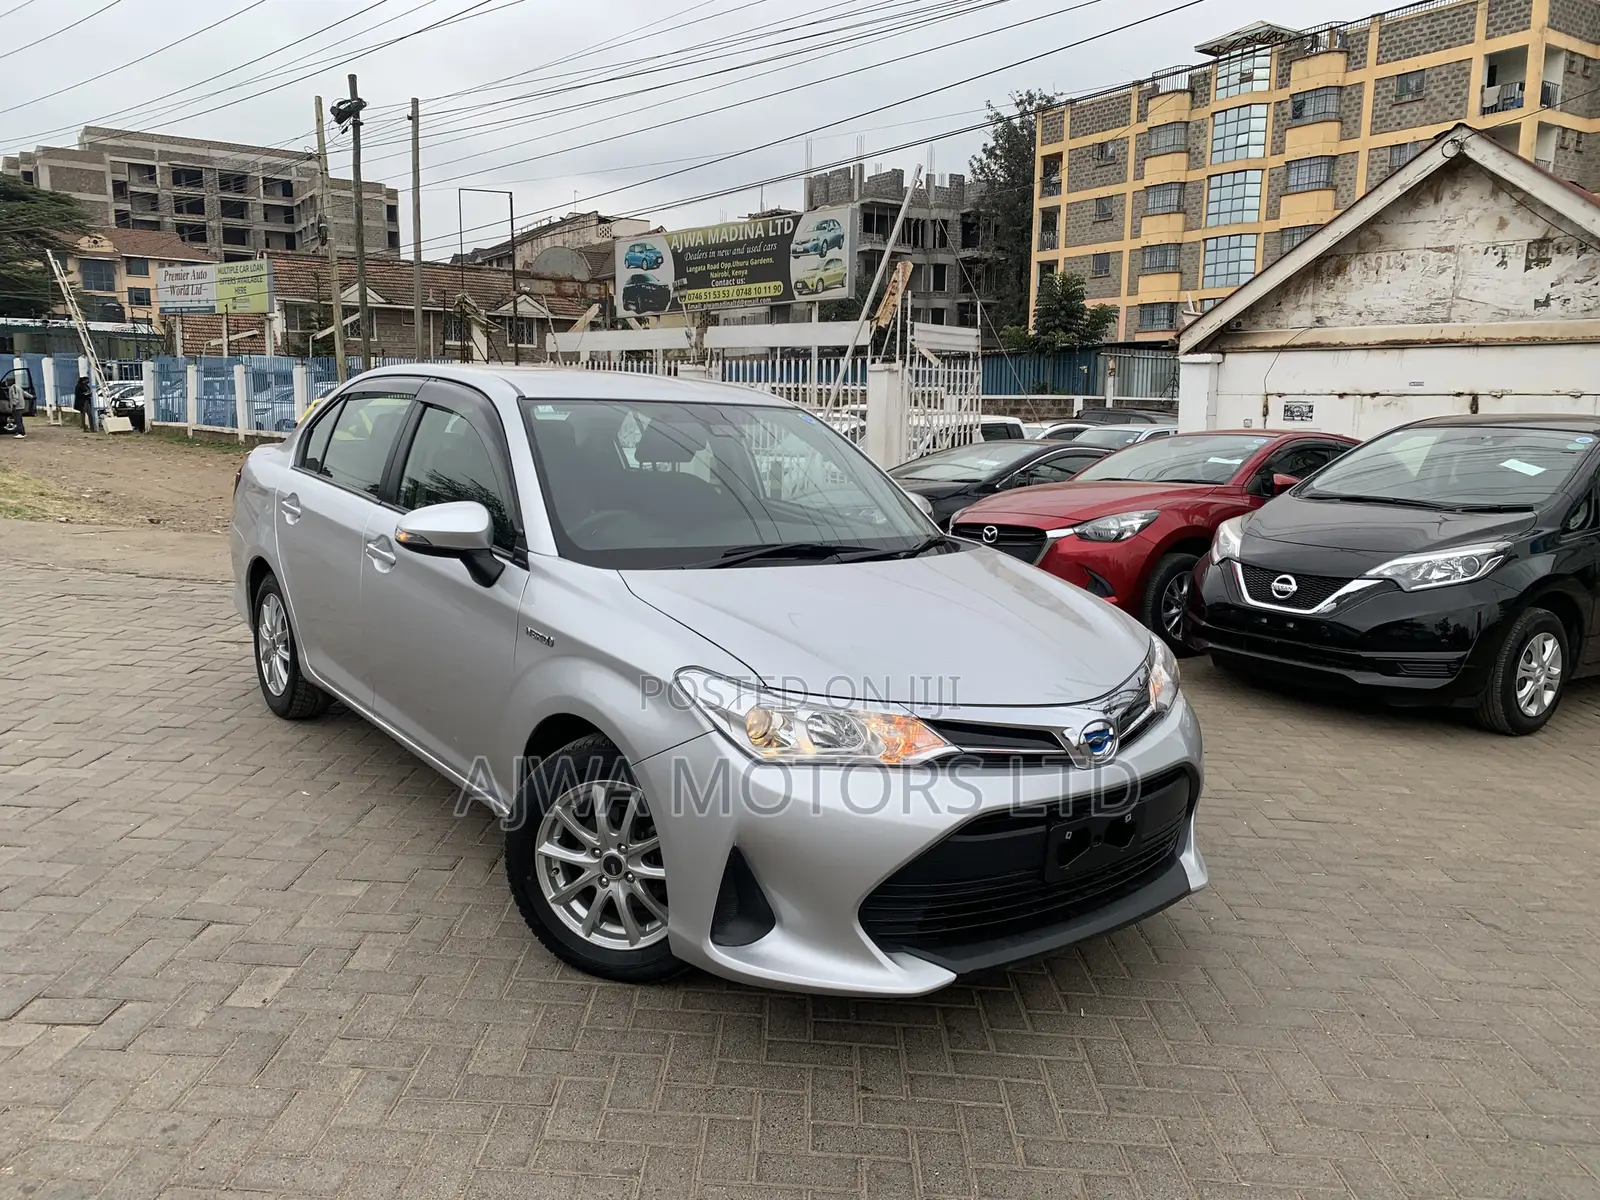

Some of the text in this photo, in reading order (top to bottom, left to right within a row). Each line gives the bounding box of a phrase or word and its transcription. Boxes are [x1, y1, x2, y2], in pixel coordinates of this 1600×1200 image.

[671, 217, 794, 253] AJWA MADINA LTD
[683, 241, 777, 261] Dealers in new and used cars
[217, 263, 264, 275] MULTIPLE CAR LOAN
[686, 264, 706, 273] Langata
[707, 262, 719, 271] Road
[732, 269, 748, 278] Kenya
[163, 269, 208, 281] Premier Auto
[220, 276, 237, 285] OFFERS
[711, 277, 746, 287] Contact us:
[170, 283, 203, 296] World Ltd
[234, 286, 247, 295] HERE
[687, 291, 703, 301] 0746
[704, 291, 711, 300] 51
[712, 290, 721, 299] 53
[722, 289, 730, 299] 53
[736, 287, 752, 297] 0748
[754, 286, 762, 295] 10
[764, 285, 771, 294] 11
[773, 284, 782, 294] 90
